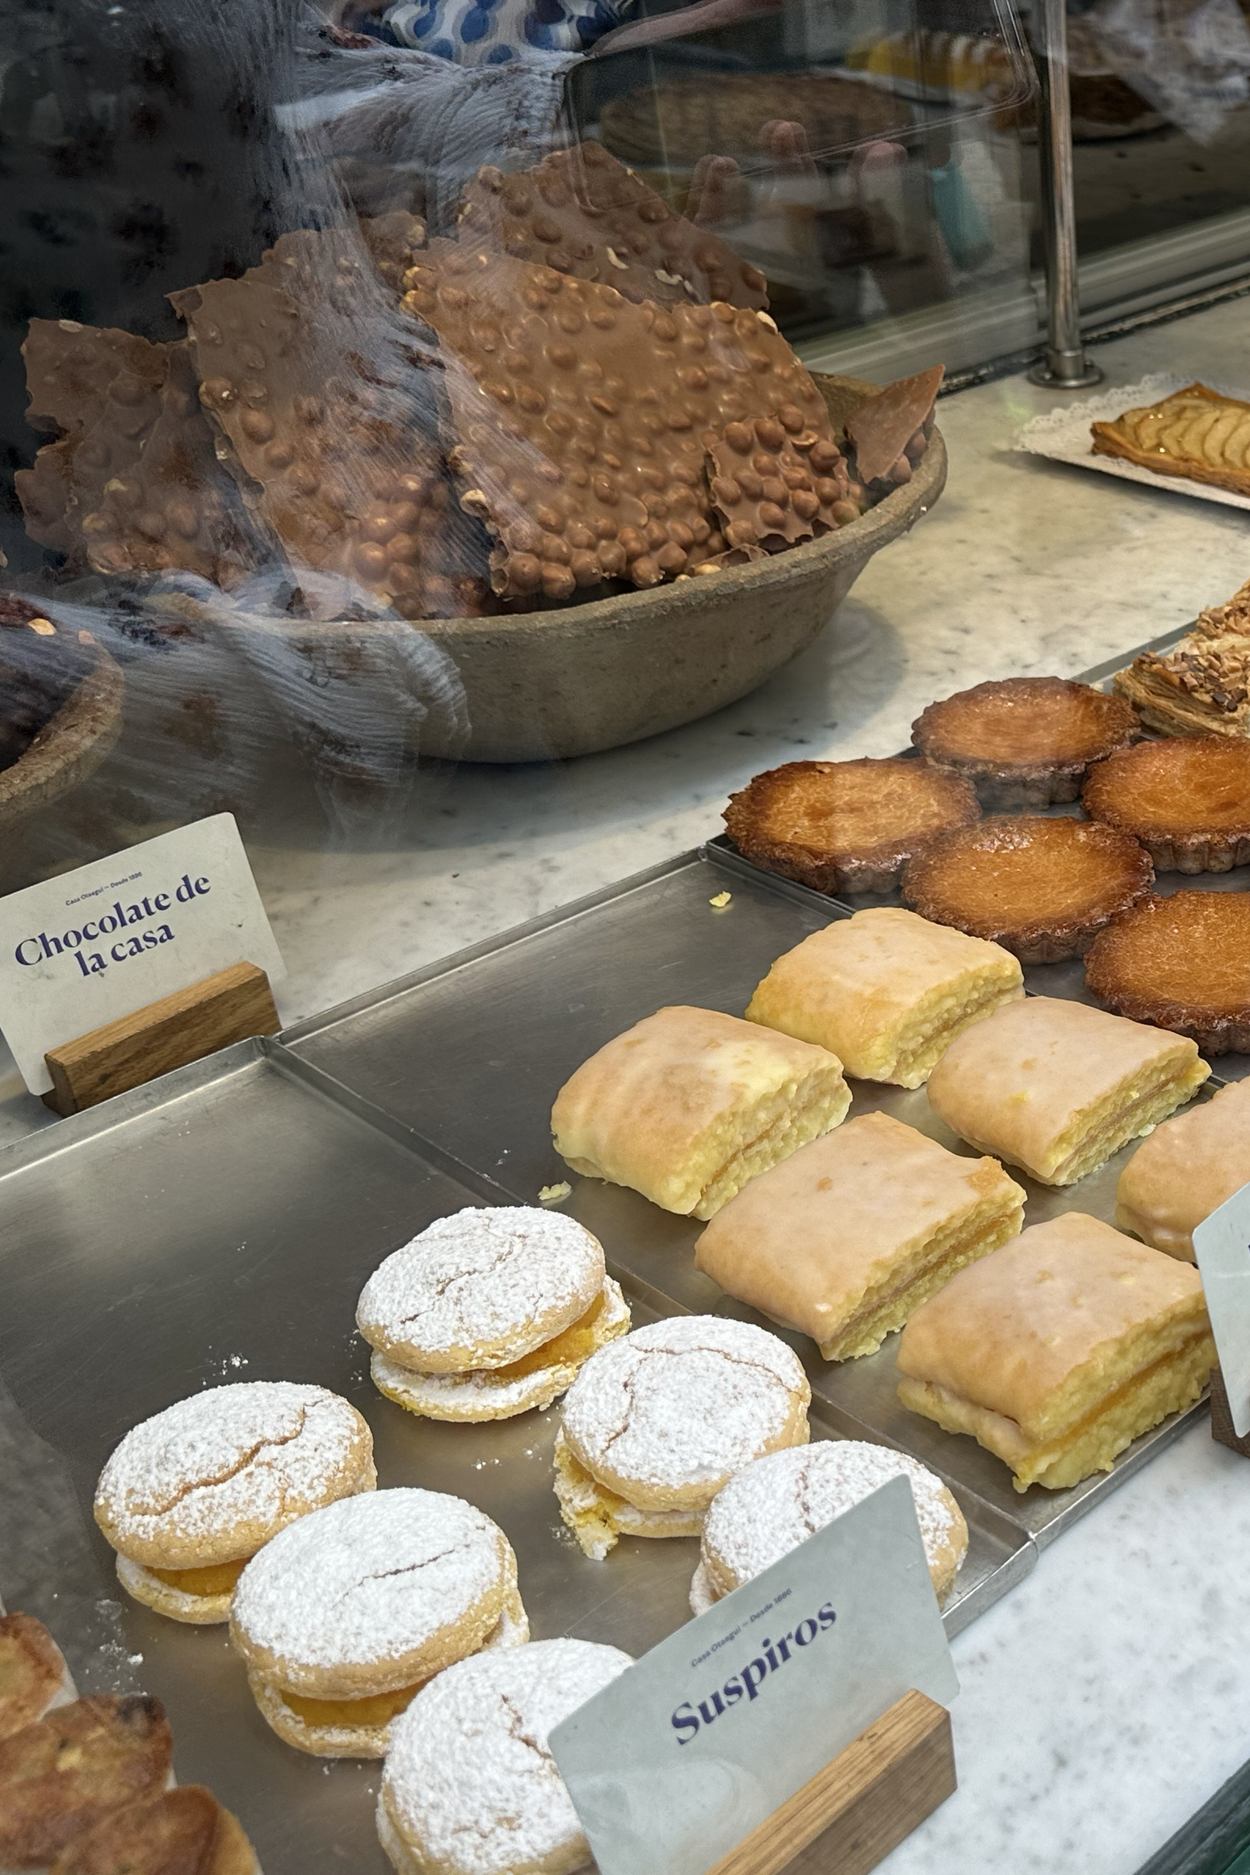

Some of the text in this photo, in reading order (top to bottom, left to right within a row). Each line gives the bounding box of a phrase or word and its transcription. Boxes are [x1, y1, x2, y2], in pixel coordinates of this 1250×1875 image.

[15, 874, 212, 966] Chocolate de
[74, 924, 175, 977] la casa
[750, 1603, 773, 1623] Desde
[670, 1601, 837, 1745] Suspiros
